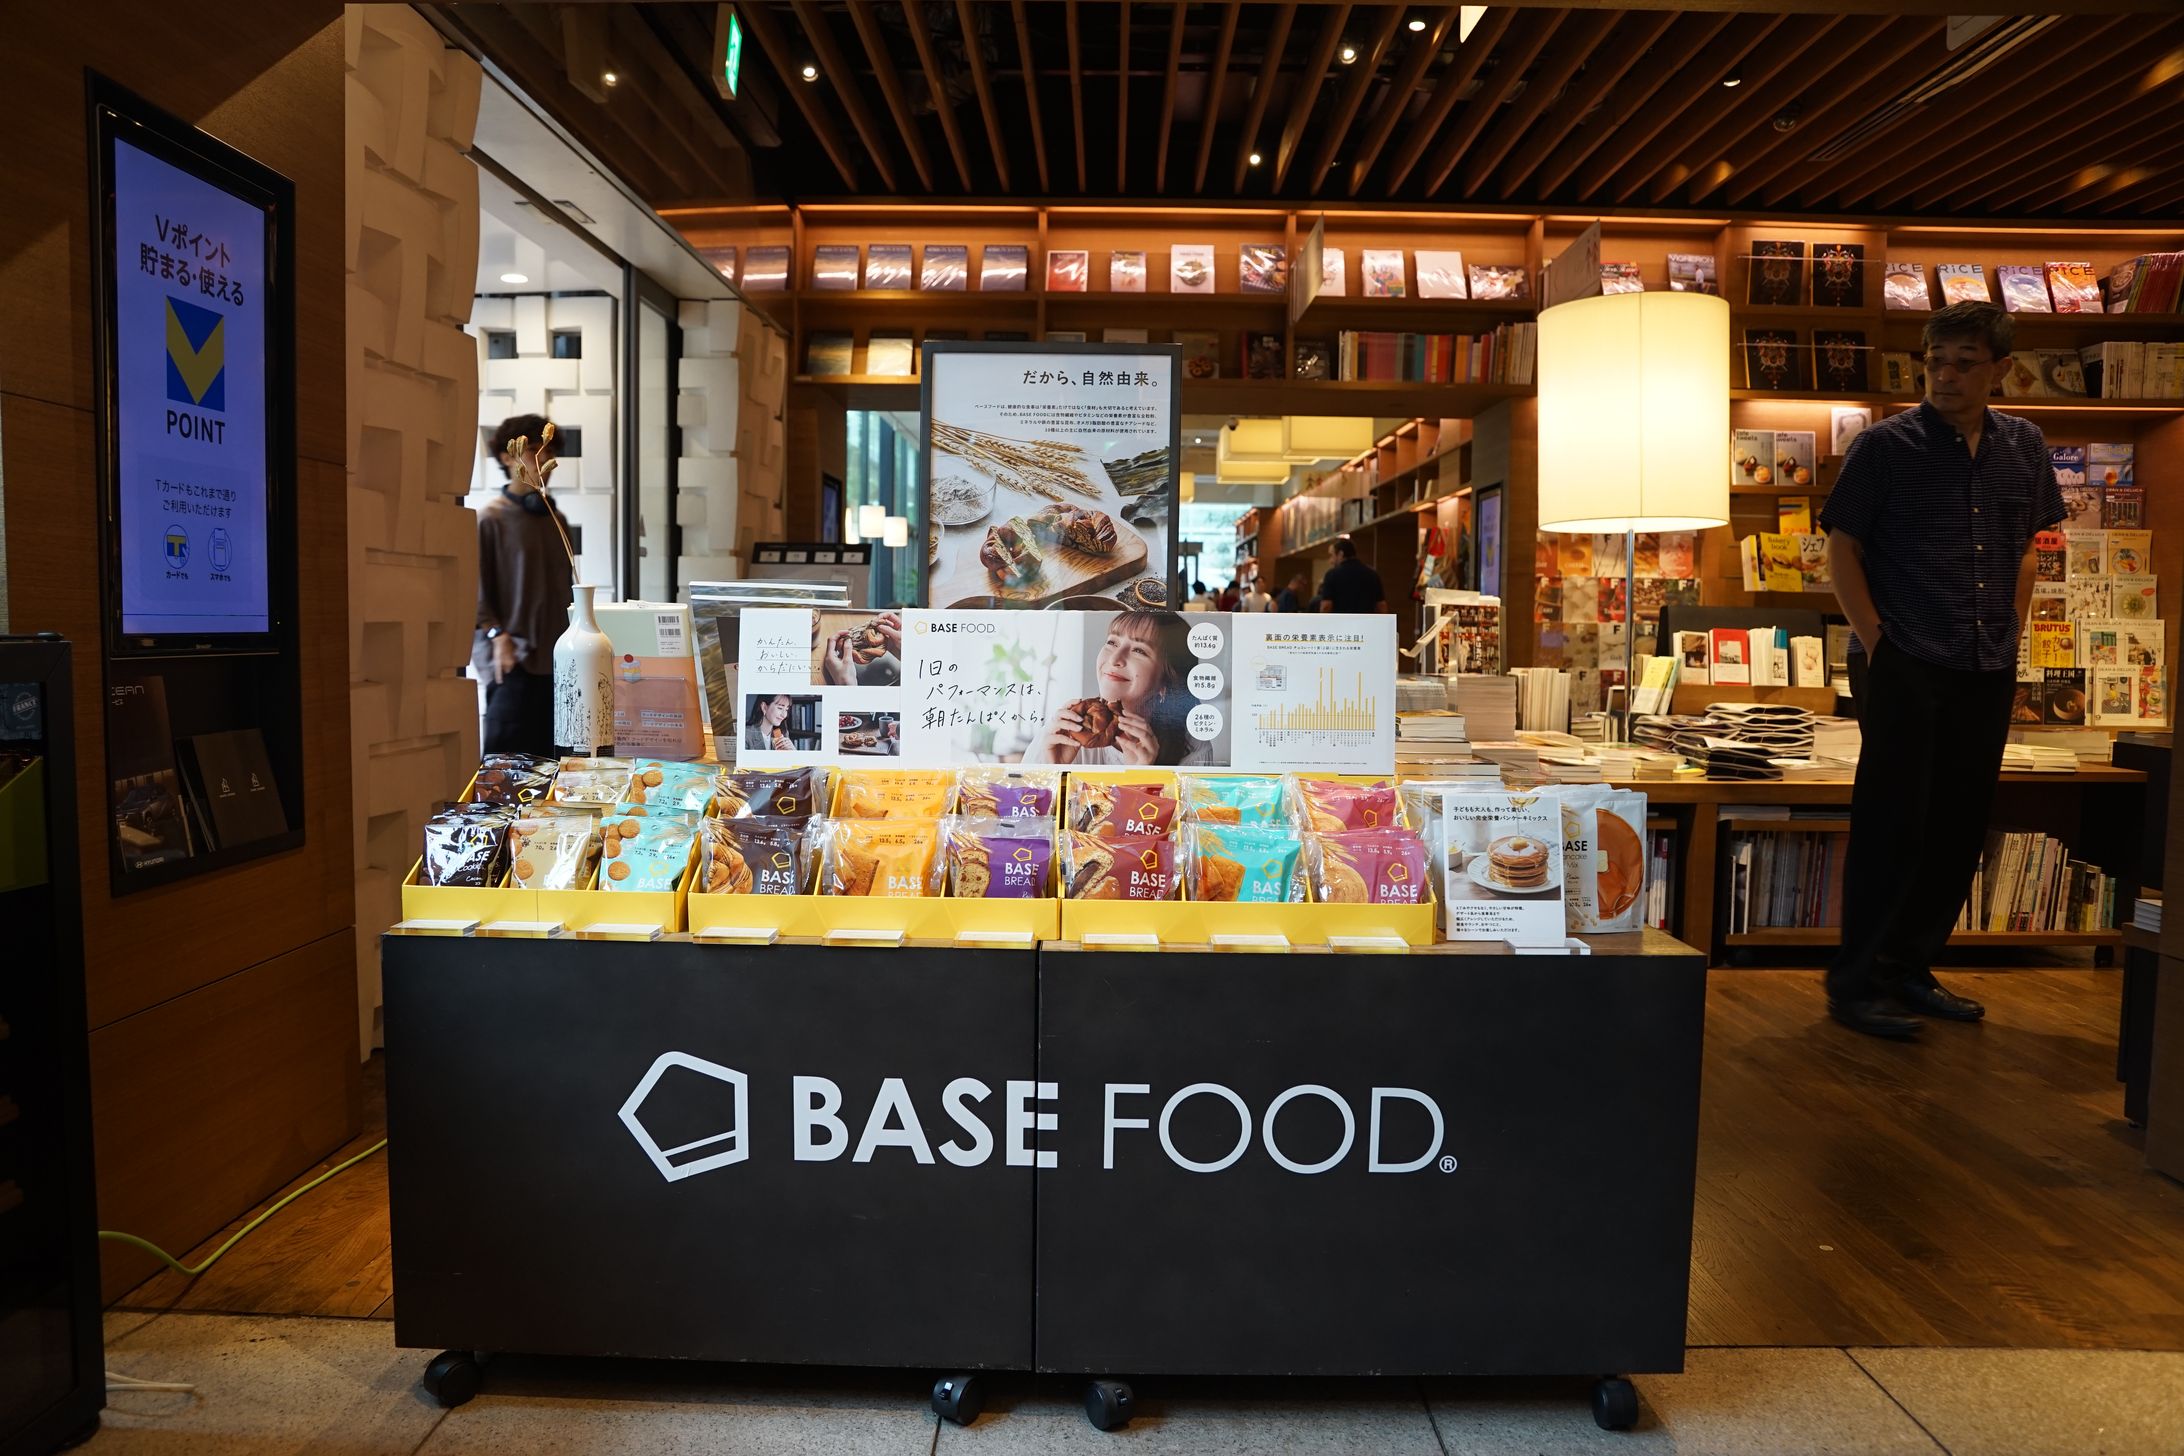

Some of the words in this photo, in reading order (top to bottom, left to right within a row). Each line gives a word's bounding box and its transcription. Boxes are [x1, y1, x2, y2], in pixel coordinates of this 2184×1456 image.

[155, 214, 230, 268] Vポイント
[140, 242, 244, 306] 貯まる・使える
[1023, 370, 1158, 387] だから、自然由来。
[167, 409, 226, 445] POINT
[155, 479, 237, 502] Tカードもこれまで通り
[162, 499, 232, 518] ご利用いただけます
[931, 623, 957, 633] BASE
[1613, 625, 1621, 635] F
[2034, 624, 2071, 632] BRUTUS
[1194, 642, 1216, 650] 約13.6g
[918, 659, 958, 680] 1日の
[926, 682, 1042, 701] パフォーマンスは、
[921, 707, 1046, 730] 朝たんぱくから。
[466, 851, 491, 862] ASE
[1005, 862, 1039, 876] BASE
[1130, 870, 1166, 888] BASE
[1380, 884, 1418, 898] BASE
[793, 1075, 1059, 1169] BASE
